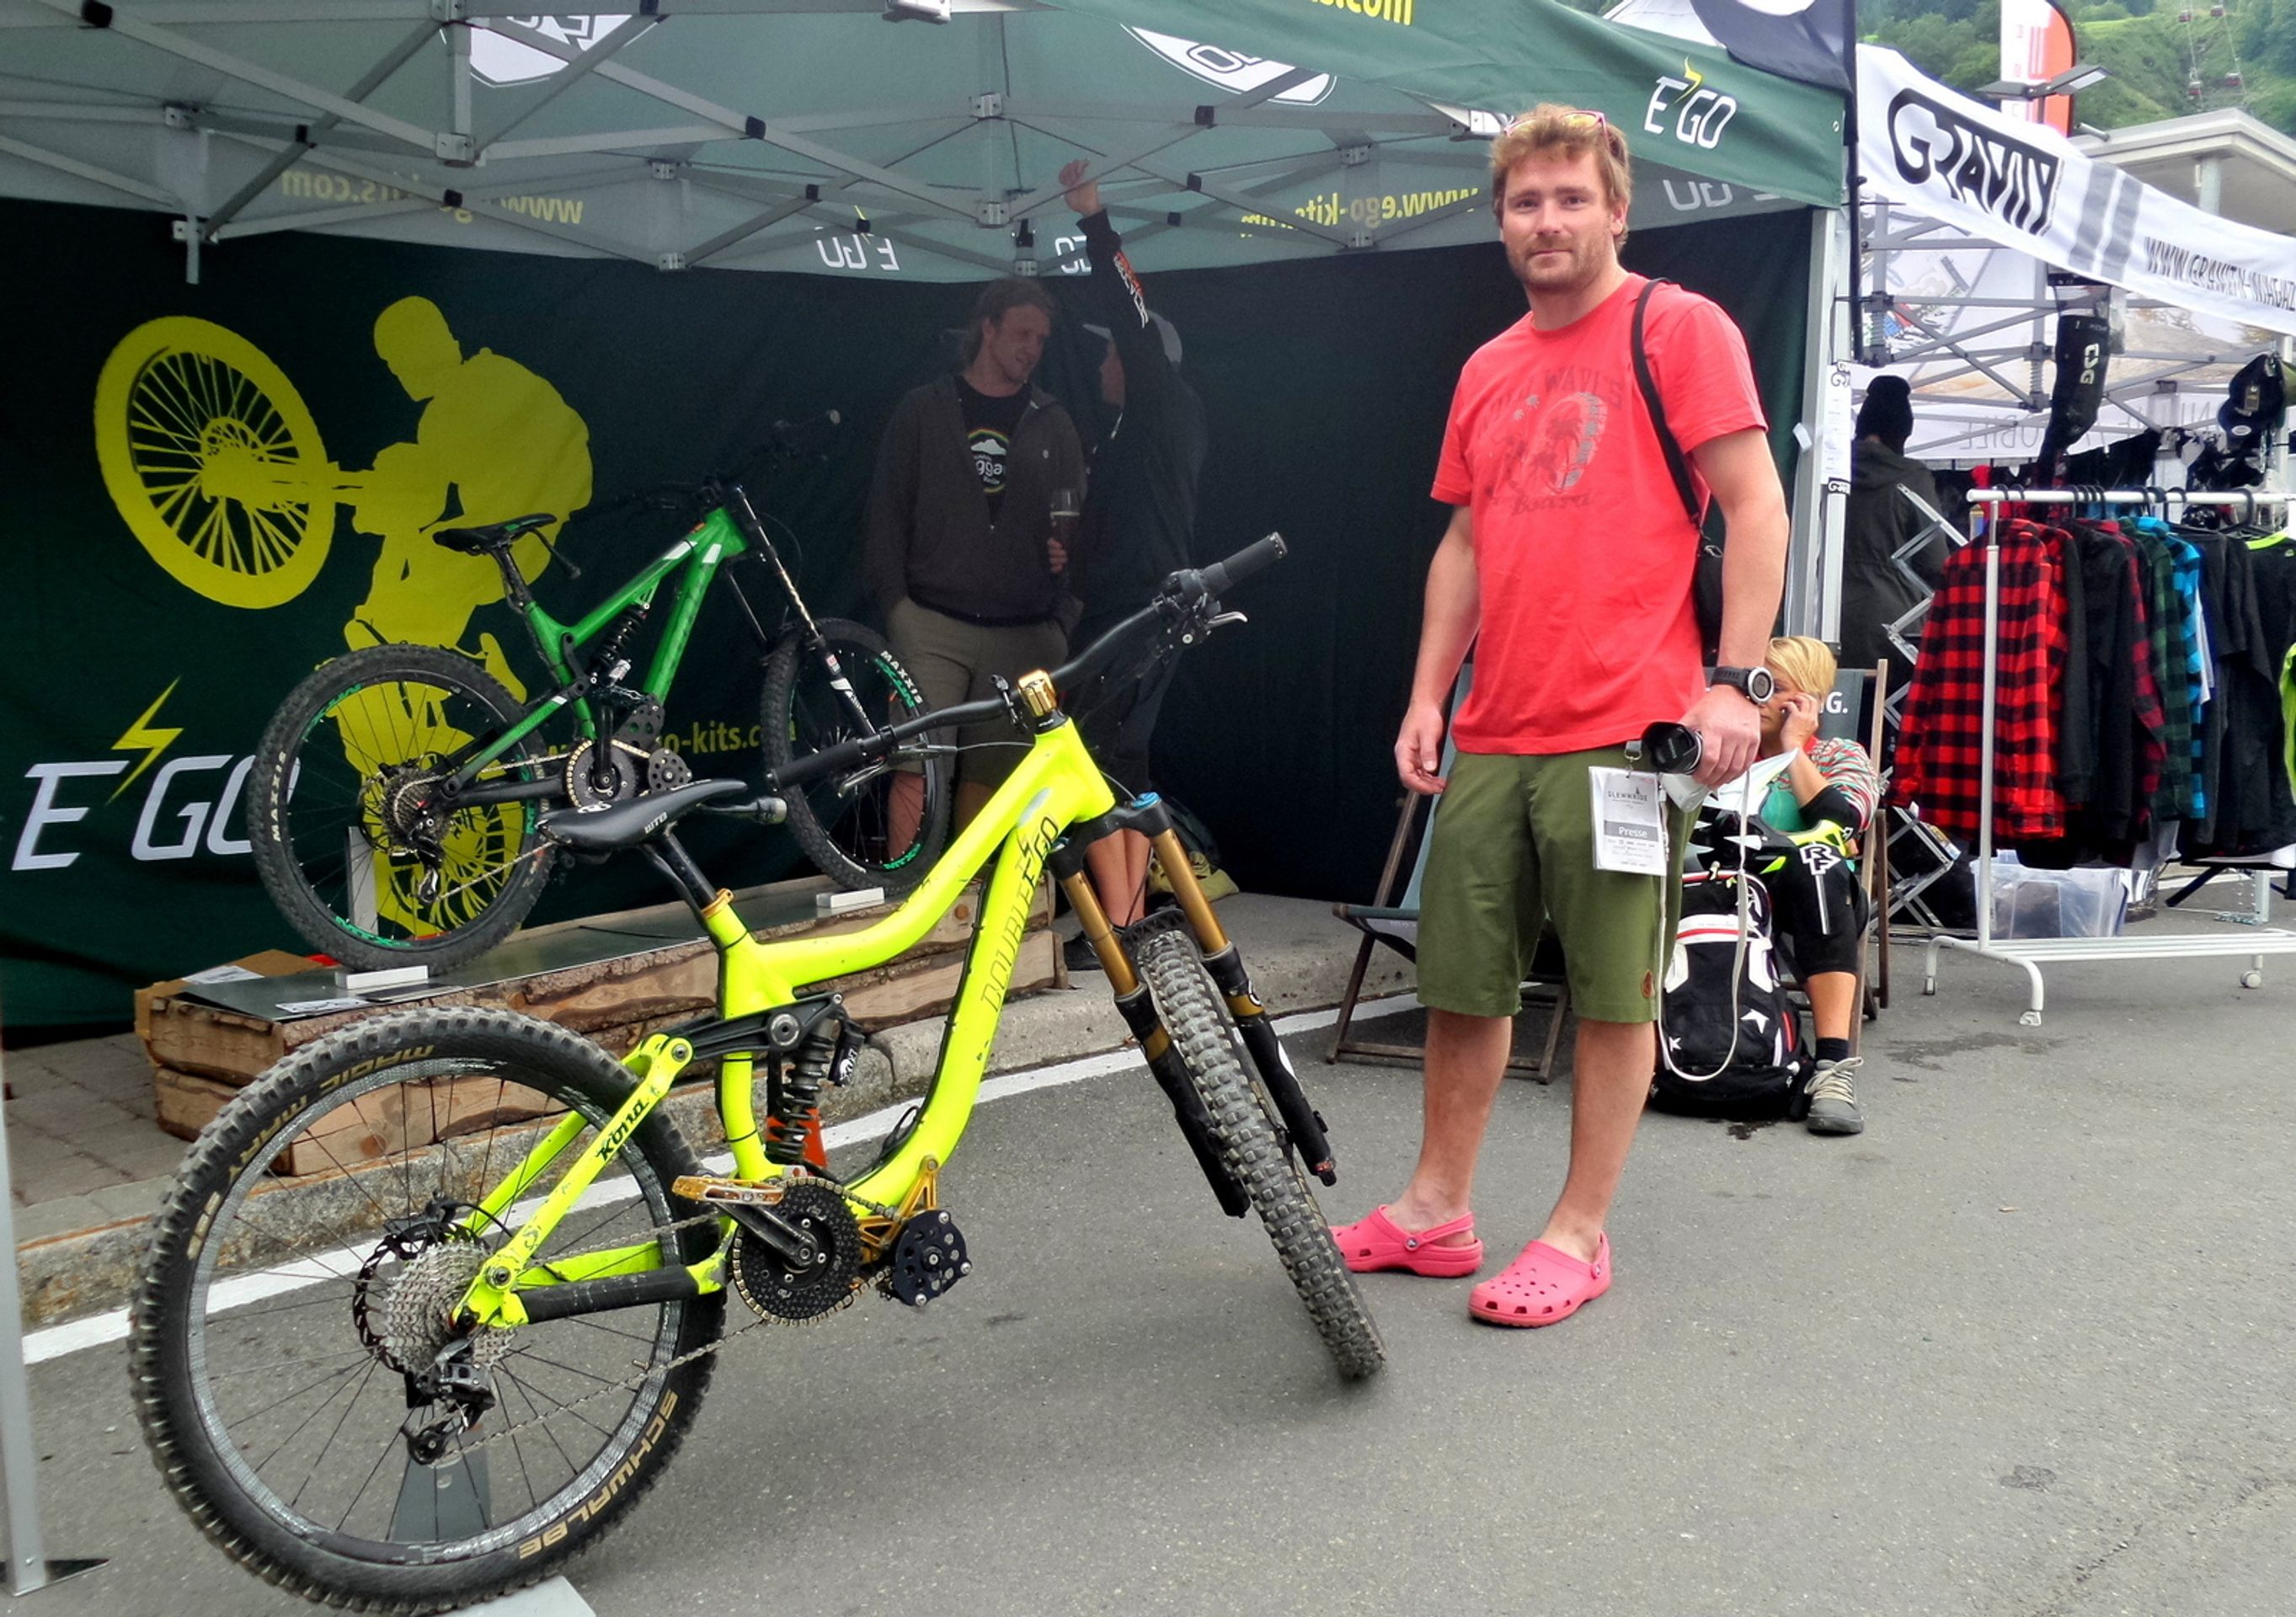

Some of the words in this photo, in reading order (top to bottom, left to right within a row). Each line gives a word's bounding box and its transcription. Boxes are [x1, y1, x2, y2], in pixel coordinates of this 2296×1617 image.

[1887, 87, 2060, 237] GRAVITY
[880, 650, 924, 705] MAXXIS
[270, 750, 287, 842] MAXXIS
[1618, 826, 1648, 839] Presse
[518, 1389, 679, 1560] SCHWALBE
